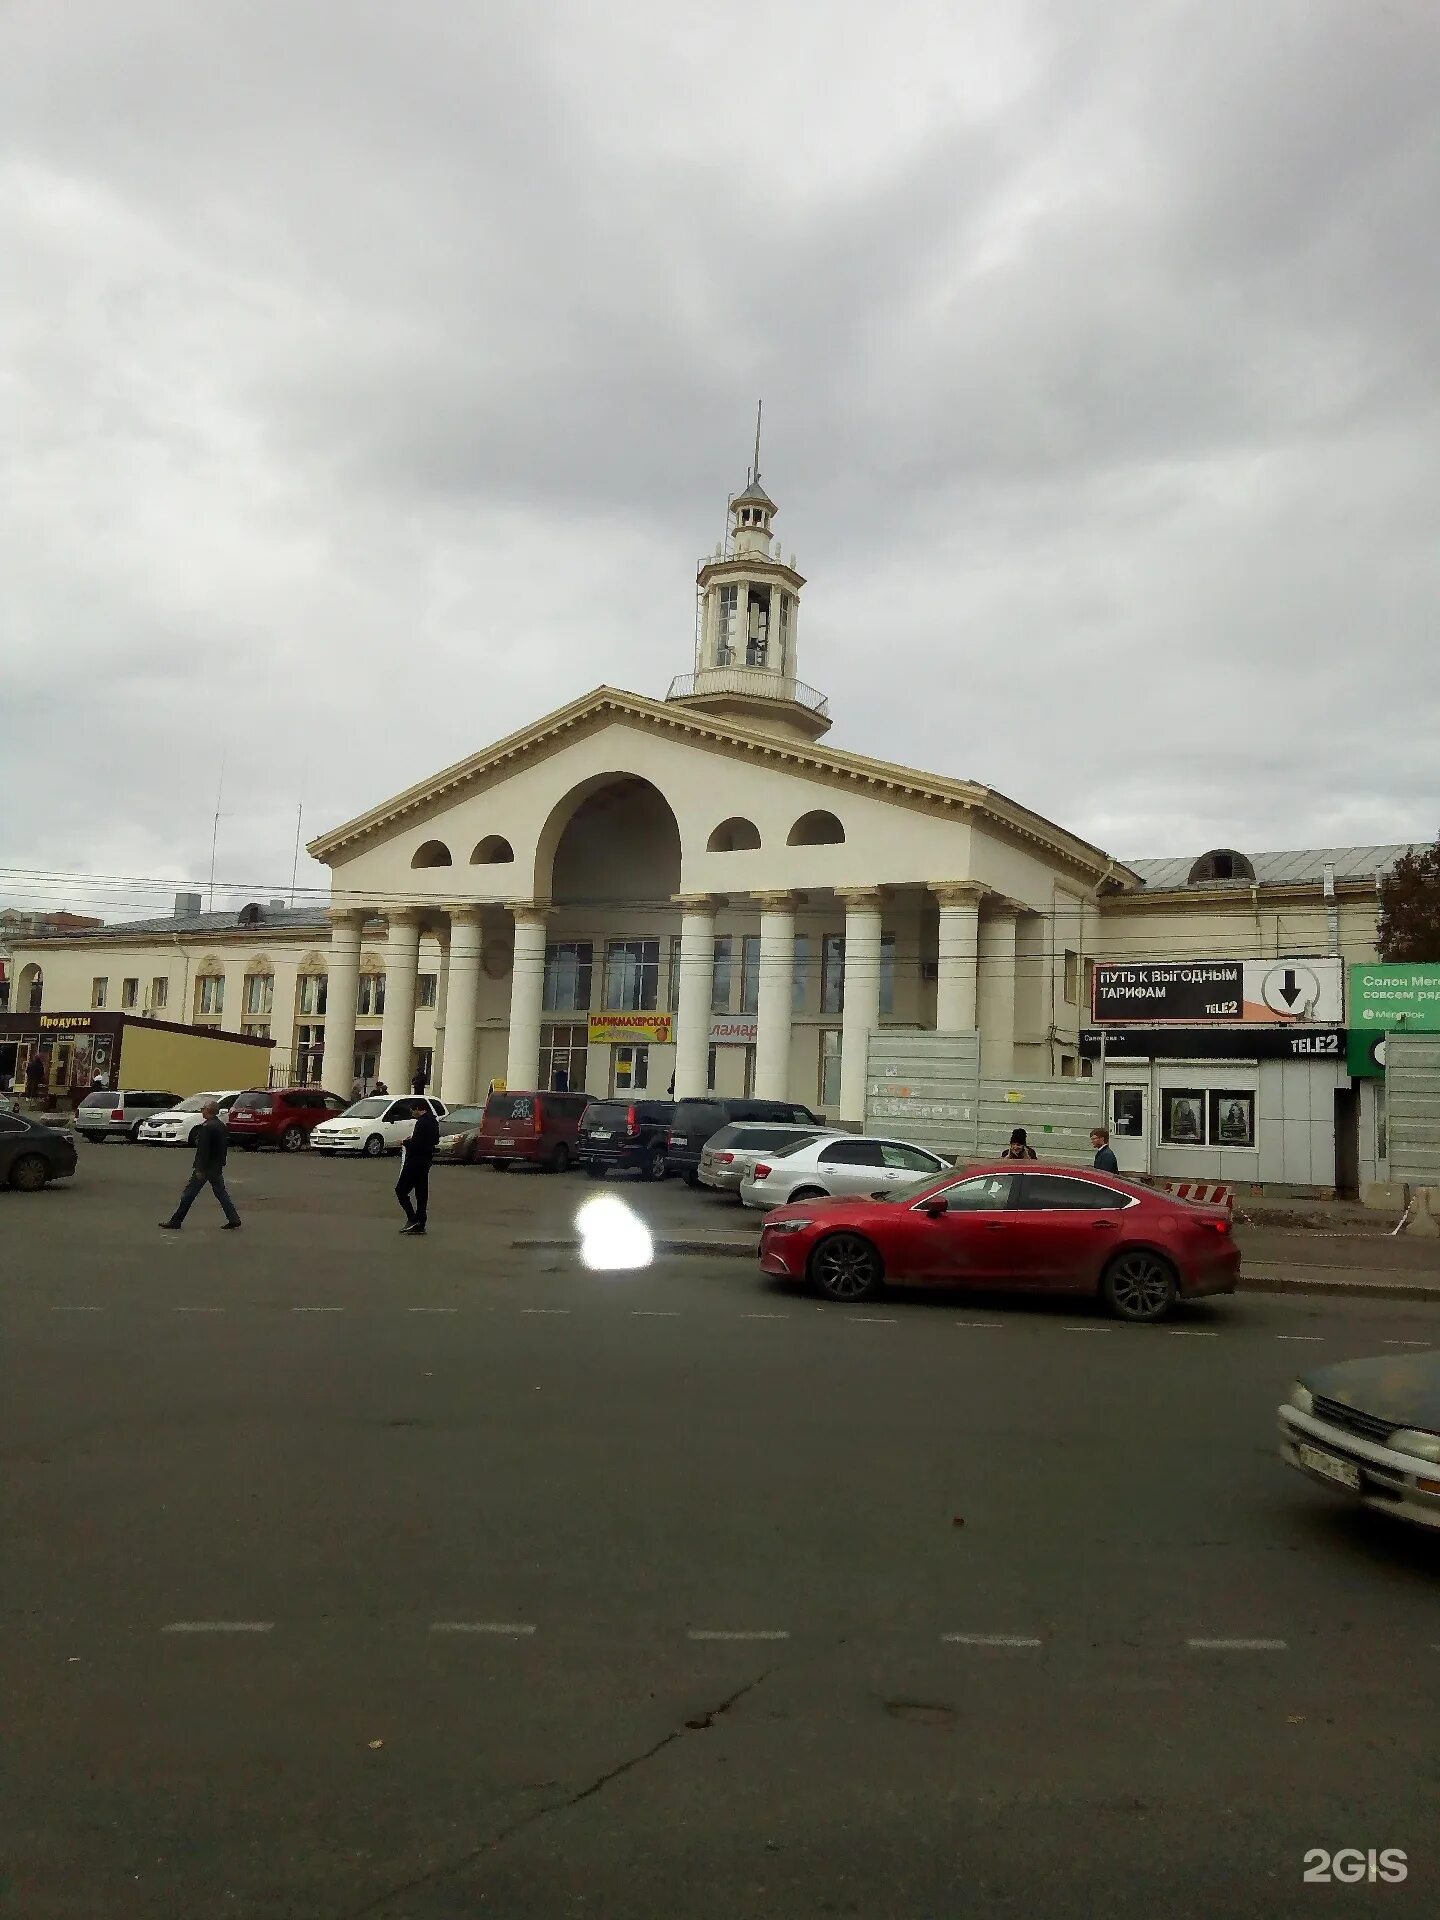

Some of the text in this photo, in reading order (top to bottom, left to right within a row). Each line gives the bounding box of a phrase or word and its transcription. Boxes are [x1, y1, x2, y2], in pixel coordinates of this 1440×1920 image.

[1100, 968, 1238, 984] ПУТЬ К ВЫГОДНЫМ
[1363, 975, 1408, 987] Салон
[1100, 986, 1166, 999] ТАРИФАМ
[1362, 991, 1413, 1000] совсем
[1205, 1000, 1238, 1014] TELE2
[40, 1015, 91, 1028] Продукты
[590, 1016, 672, 1027] ПАРИКМАХЕРСКАЯ
[1291, 1034, 1339, 1053] TELE2
